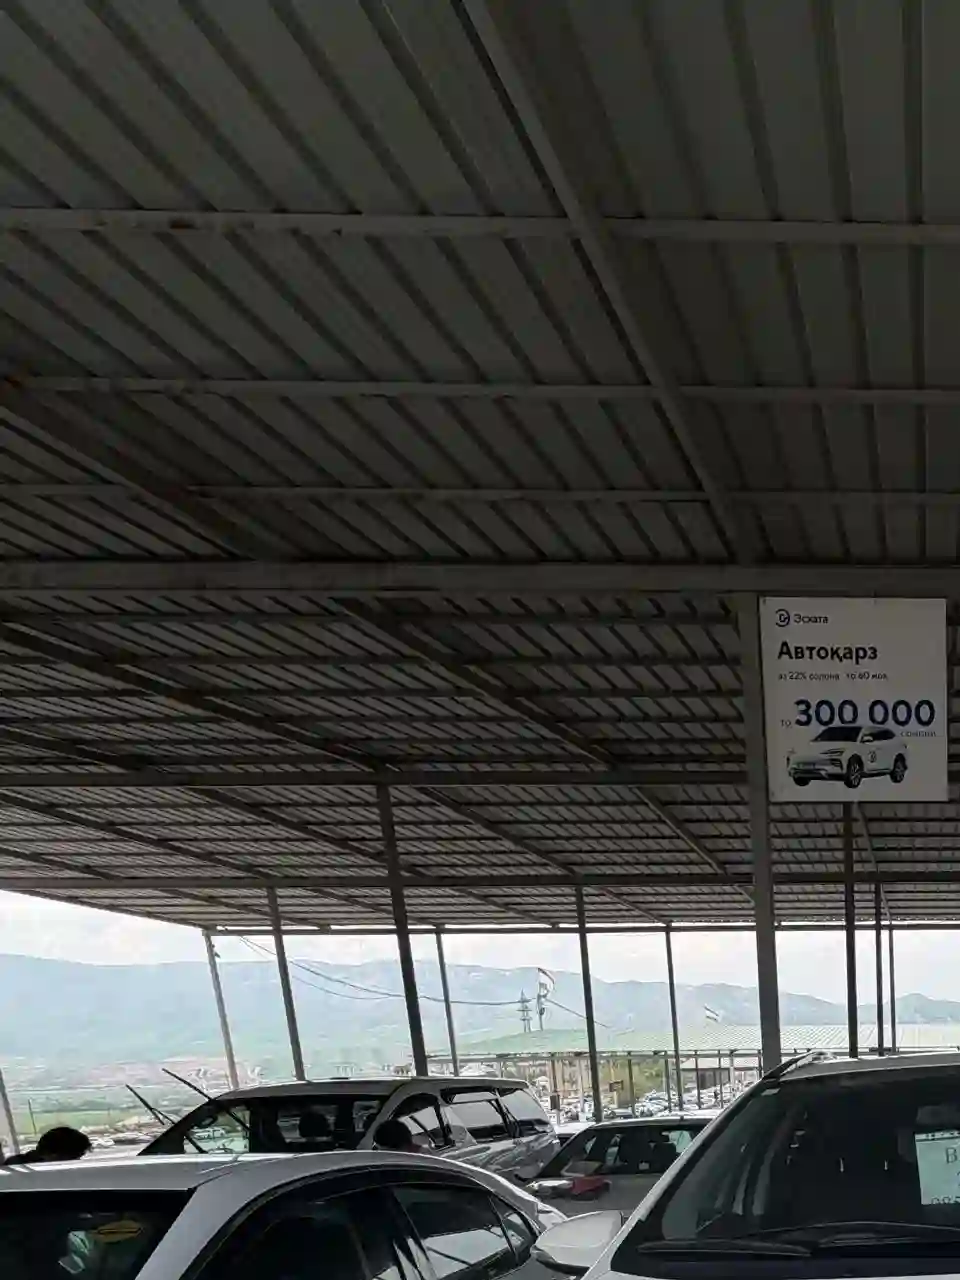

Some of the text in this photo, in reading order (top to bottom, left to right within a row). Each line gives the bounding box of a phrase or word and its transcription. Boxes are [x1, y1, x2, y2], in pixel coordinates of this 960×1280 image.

[777, 641, 878, 665] Автоқарз
[794, 699, 859, 727] 300
[868, 699, 936, 727] 000
